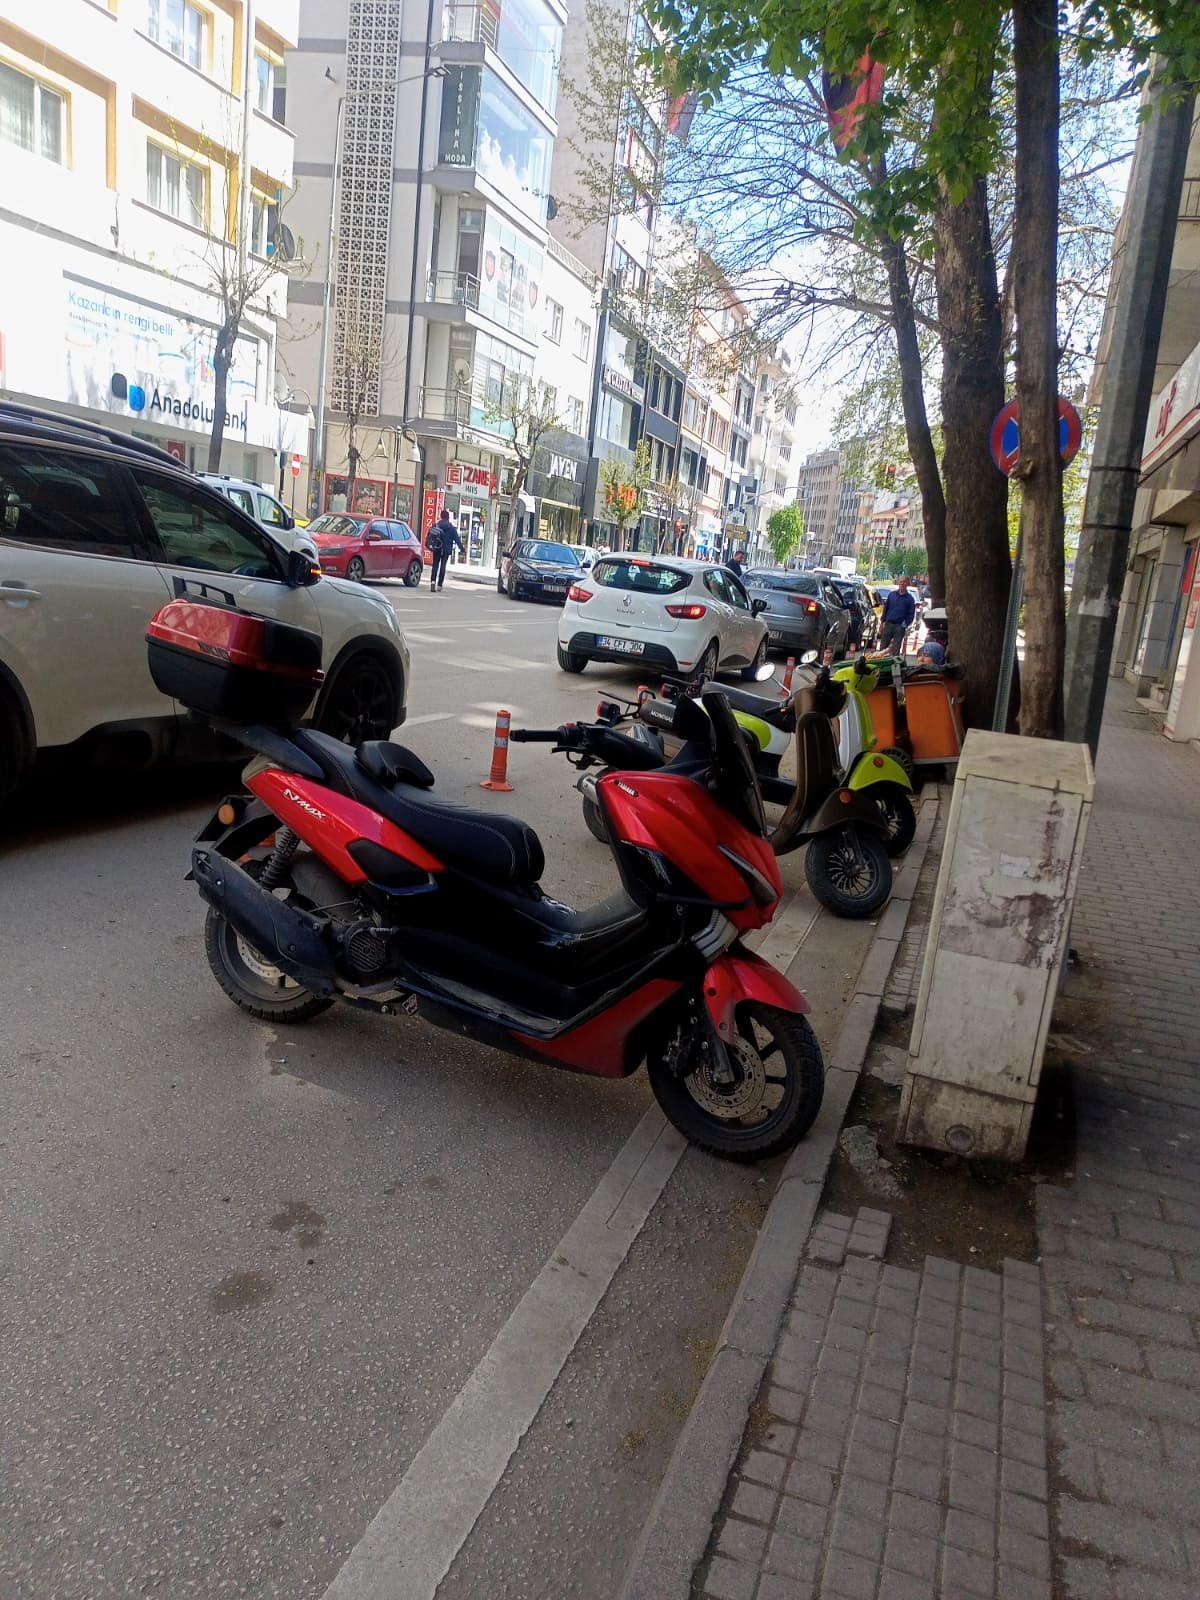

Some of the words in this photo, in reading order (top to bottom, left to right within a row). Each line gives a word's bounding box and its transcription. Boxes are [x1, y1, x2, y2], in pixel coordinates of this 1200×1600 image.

[445, 153, 466, 163] MODA
[150, 388, 248, 432] Anadoluank
[423, 497, 435, 559] ECZE
[283, 788, 327, 819] NMAX
